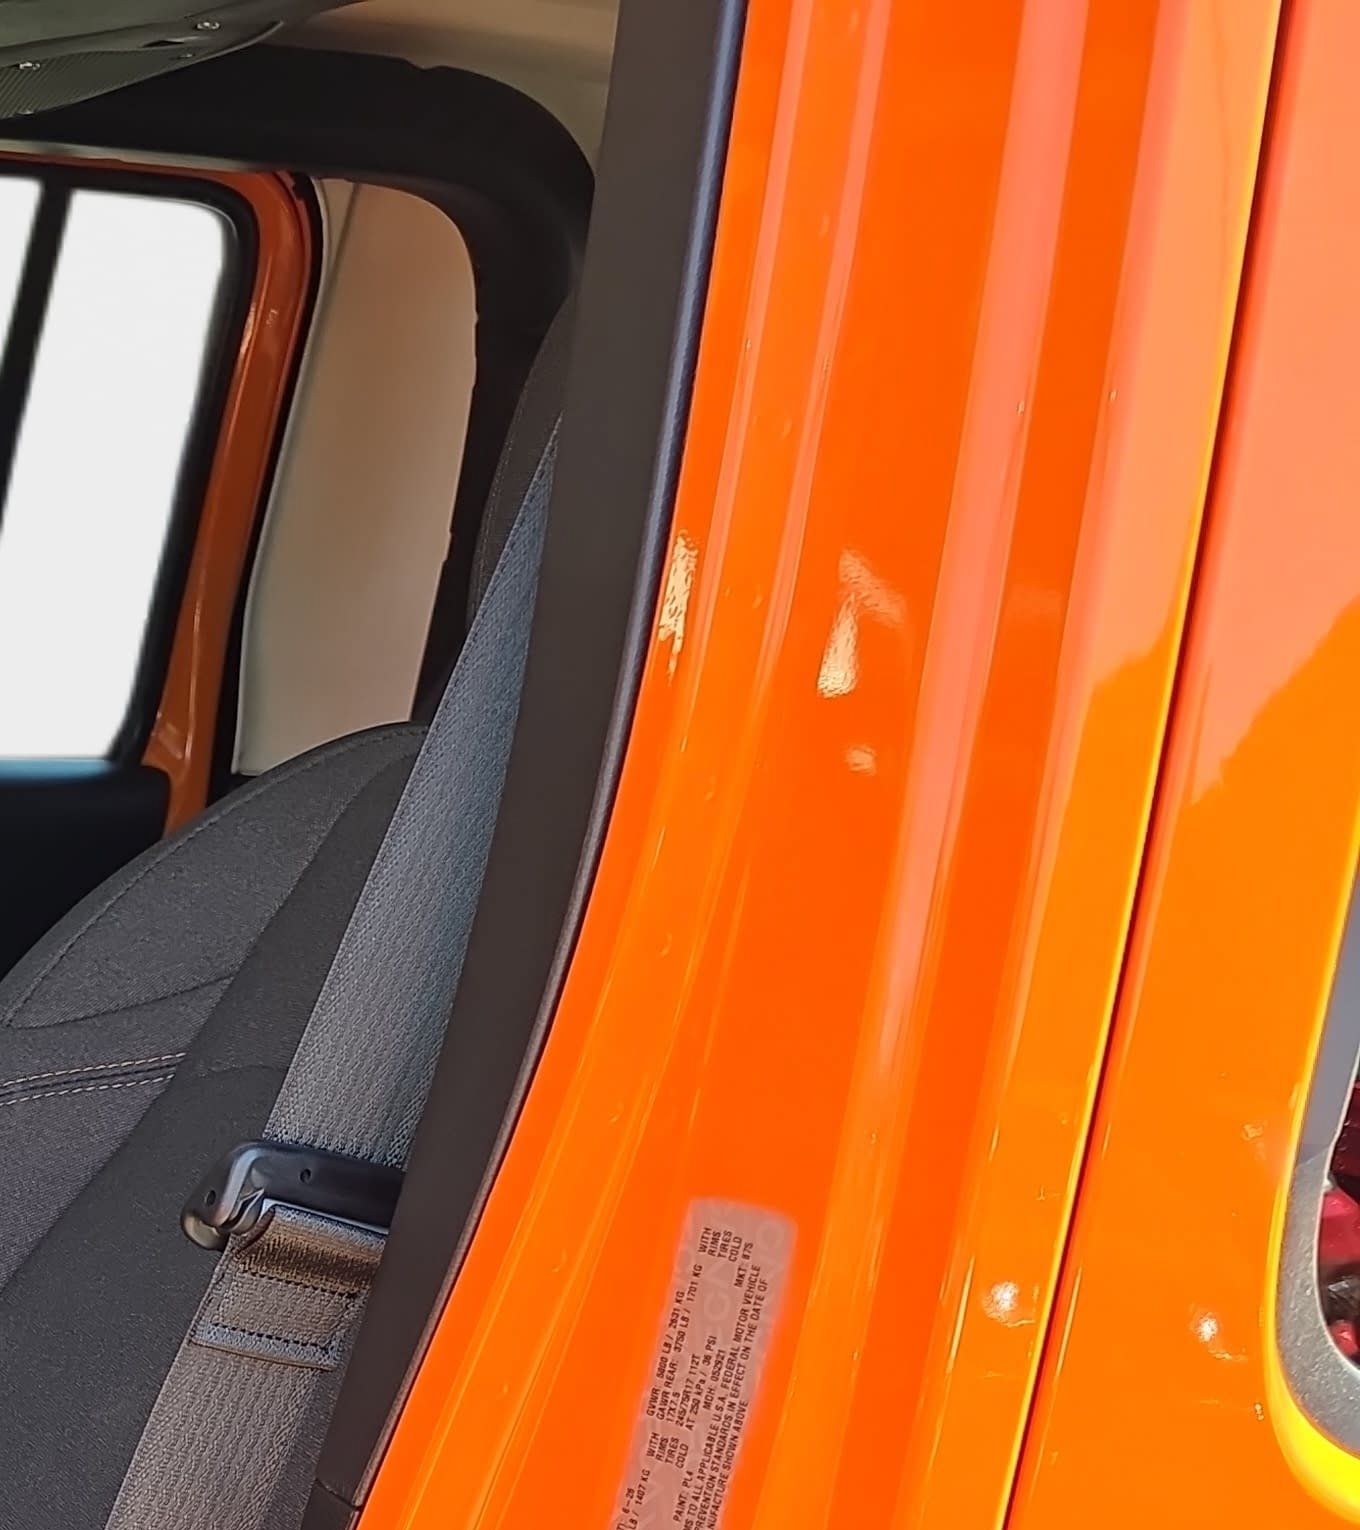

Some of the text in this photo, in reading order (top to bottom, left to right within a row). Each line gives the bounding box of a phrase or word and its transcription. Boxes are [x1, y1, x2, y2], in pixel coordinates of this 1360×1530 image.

[697, 1227, 711, 1252] WITH
[707, 1231, 720, 1256] RIMS
[717, 1230, 732, 1257] TIRES
[728, 1236, 742, 1262] COLD
[675, 1291, 684, 1304] KG
[742, 1265, 760, 1304] VEHICLE
[757, 1278, 767, 1291] OF
[750, 1294, 764, 1320] DATE
[732, 1308, 749, 1342] MOTOR
[744, 1323, 757, 1342] THE
[656, 1390, 670, 1420] GAWR
[686, 1281, 698, 1301] 1701
[692, 1264, 702, 1277] KG
[740, 1346, 751, 1360] ON
[720, 1346, 740, 1389] FEDERAL
[729, 1362, 745, 1398] EFFECT
[685, 1417, 695, 1430] AT
[705, 1335, 716, 1351] PSI
[727, 1401, 736, 1411] IN
[646, 1432, 659, 1456] WITH
[710, 1414, 733, 1472] STANDARDS
[722, 1434, 738, 1470] SHOWN
[732, 1400, 748, 1432] ABOVE
[655, 1437, 668, 1461] RIMS
[664, 1437, 679, 1463] TIRES
[675, 1443, 688, 1468] COLD
[696, 1424, 719, 1481] APPLICABLE
[691, 1485, 703, 1501] ALL
[687, 1503, 697, 1515] TO
